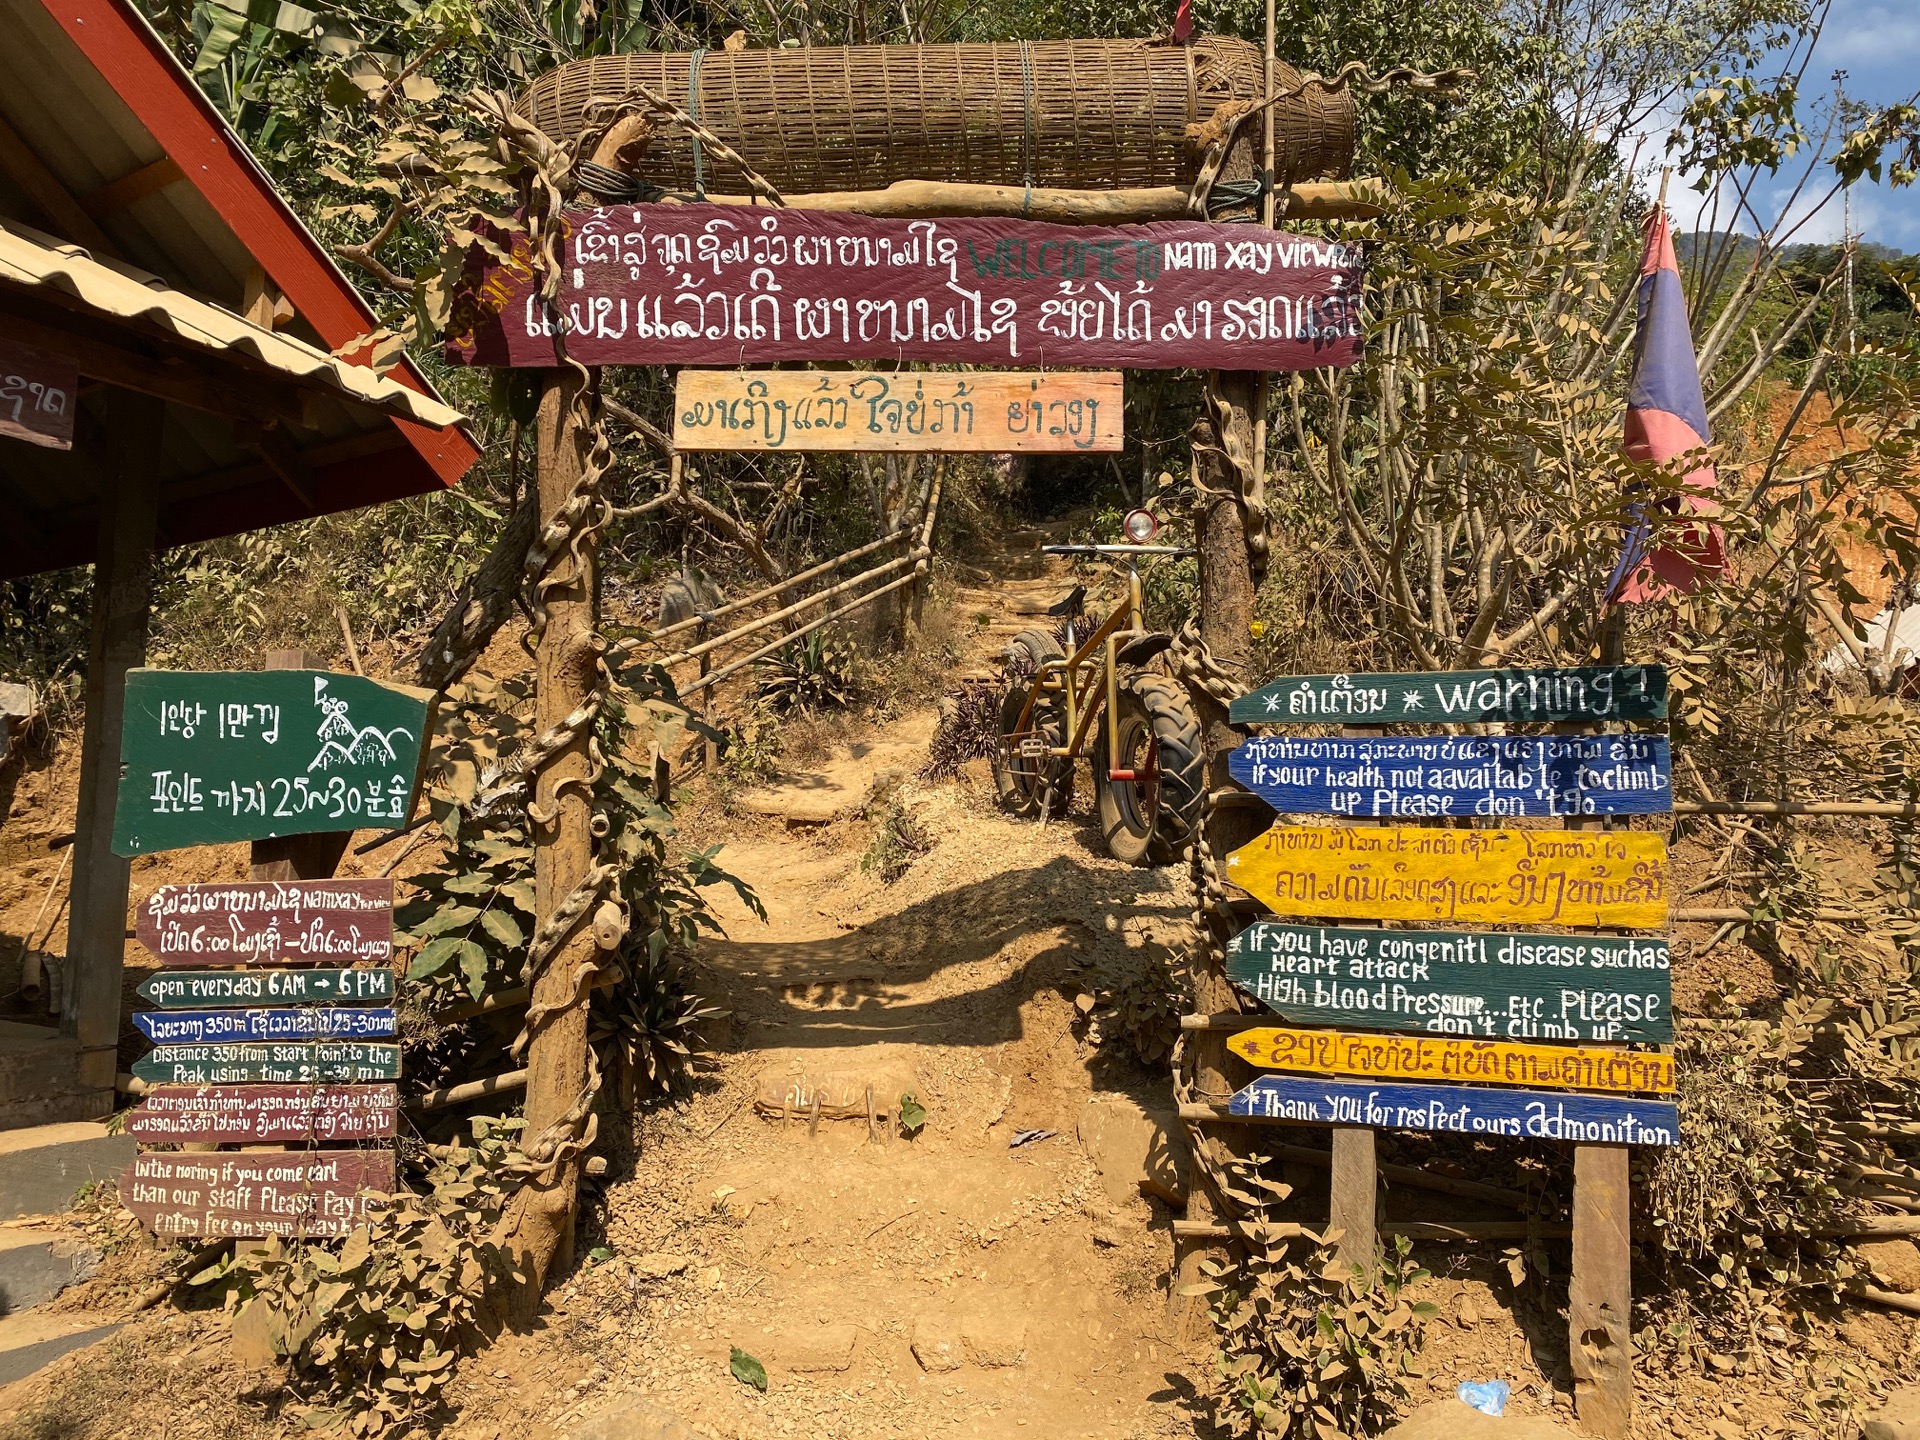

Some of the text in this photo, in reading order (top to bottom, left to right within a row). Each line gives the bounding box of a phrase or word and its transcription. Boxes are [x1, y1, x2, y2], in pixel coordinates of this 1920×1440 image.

[966, 238, 1124, 280] WELCOME
[1127, 238, 1161, 281] TO
[1252, 764, 1267, 786] If
[1269, 767, 1320, 787] your
[1325, 764, 1386, 788] health
[1390, 765, 1424, 790] not
[150, 770, 204, 813] 포인트
[210, 780, 266, 816] 까지
[1373, 789, 1454, 816] Please
[1250, 925, 1269, 952] If
[1270, 931, 1312, 953] you
[1319, 929, 1369, 957] have
[1497, 936, 1586, 967] disease
[149, 980, 185, 1003] open
[1257, 973, 1307, 1004] High
[1313, 979, 1387, 1011] blood
[1560, 989, 1661, 1022] Please
[367, 1045, 392, 1064] the
[173, 1064, 206, 1083] Peak
[259, 1063, 293, 1081] time
[1262, 1089, 1321, 1121] Thank
[1324, 1094, 1362, 1123] you
[1363, 1090, 1394, 1127] for
[1472, 1116, 1521, 1136] ours
[222, 1161, 234, 1183] if
[234, 1168, 263, 1187] you
[266, 1165, 303, 1182] come
[131, 1182, 167, 1204] than
[172, 1188, 200, 1207] our
[207, 1186, 252, 1211] staff
[154, 1211, 199, 1237] entry
[231, 1219, 253, 1237] on
